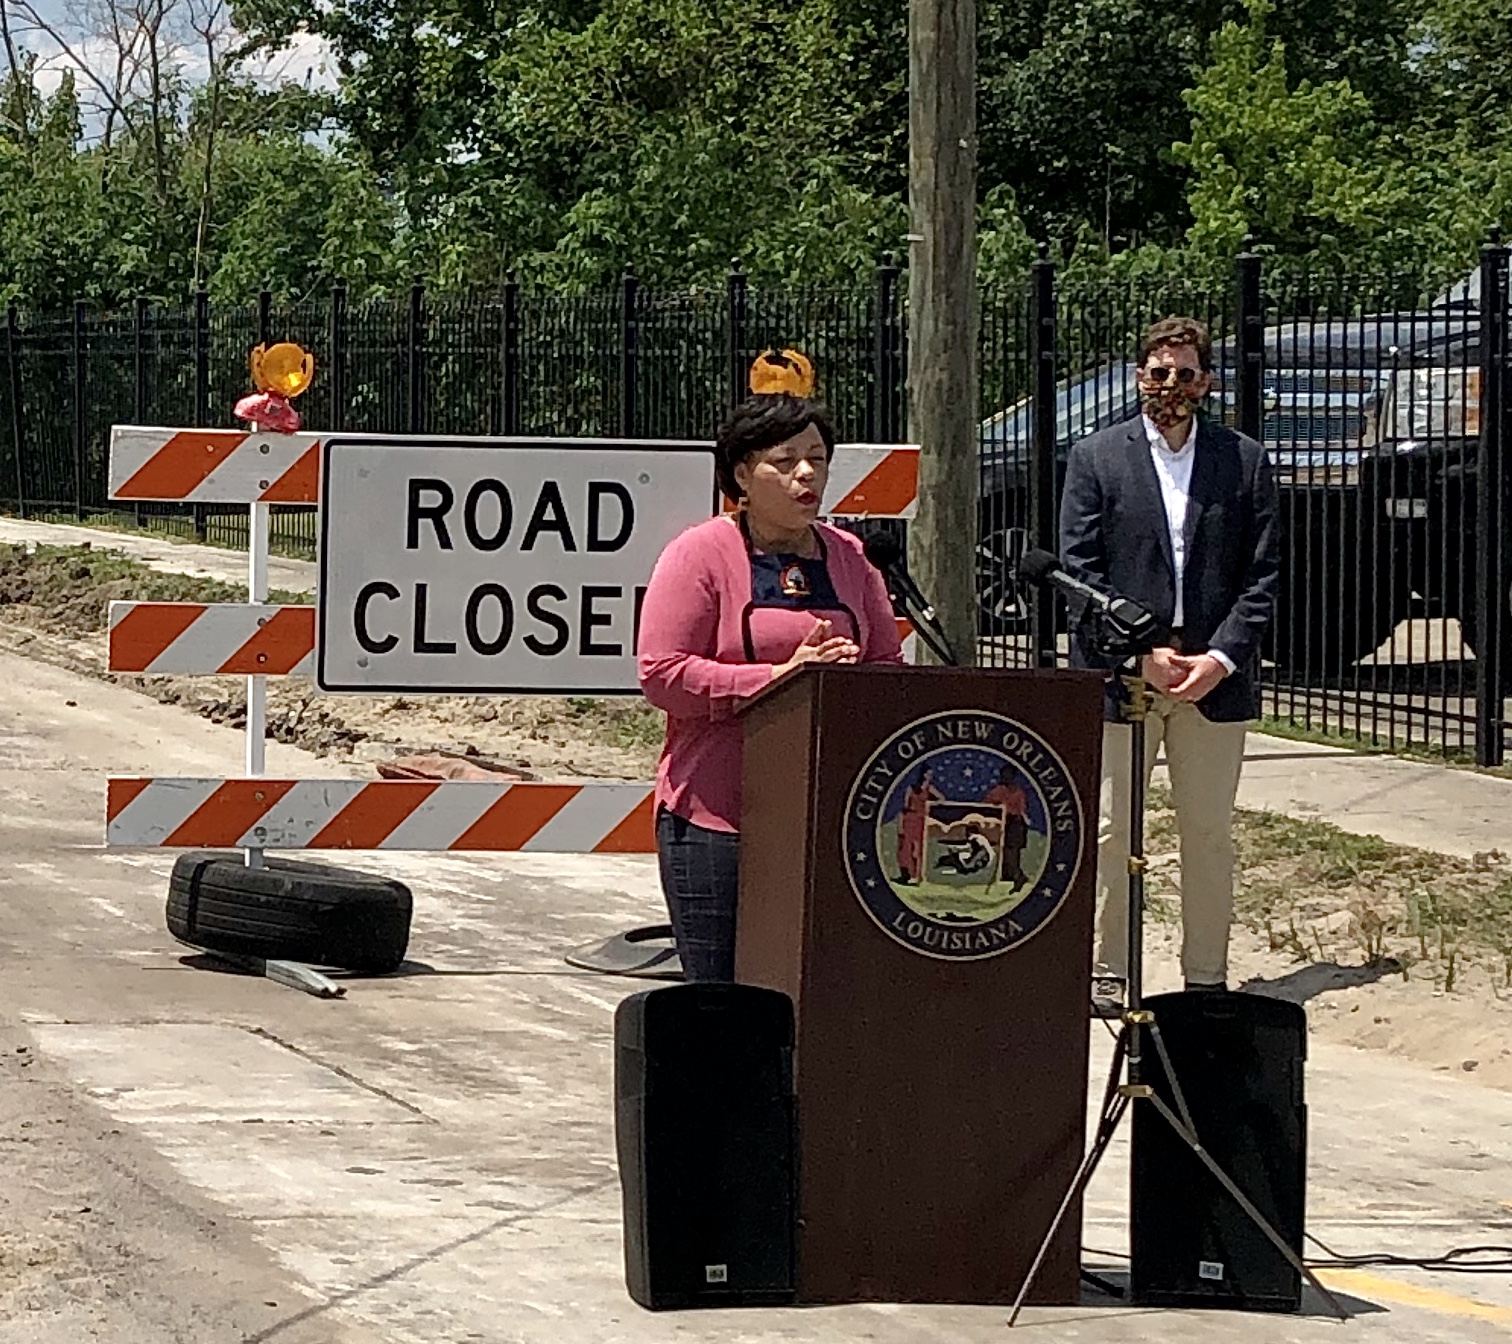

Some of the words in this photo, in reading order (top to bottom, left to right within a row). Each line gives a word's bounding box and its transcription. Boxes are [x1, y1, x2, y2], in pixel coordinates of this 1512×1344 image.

[406, 478, 635, 552] ROAD
[354, 581, 648, 656] CLOSE
[856, 759, 894, 820] CITY
[897, 731, 926, 760] OF
[936, 720, 994, 740] NEW
[1002, 732, 1074, 834] ORLEANS
[893, 911, 1024, 950] LOUISIANA
